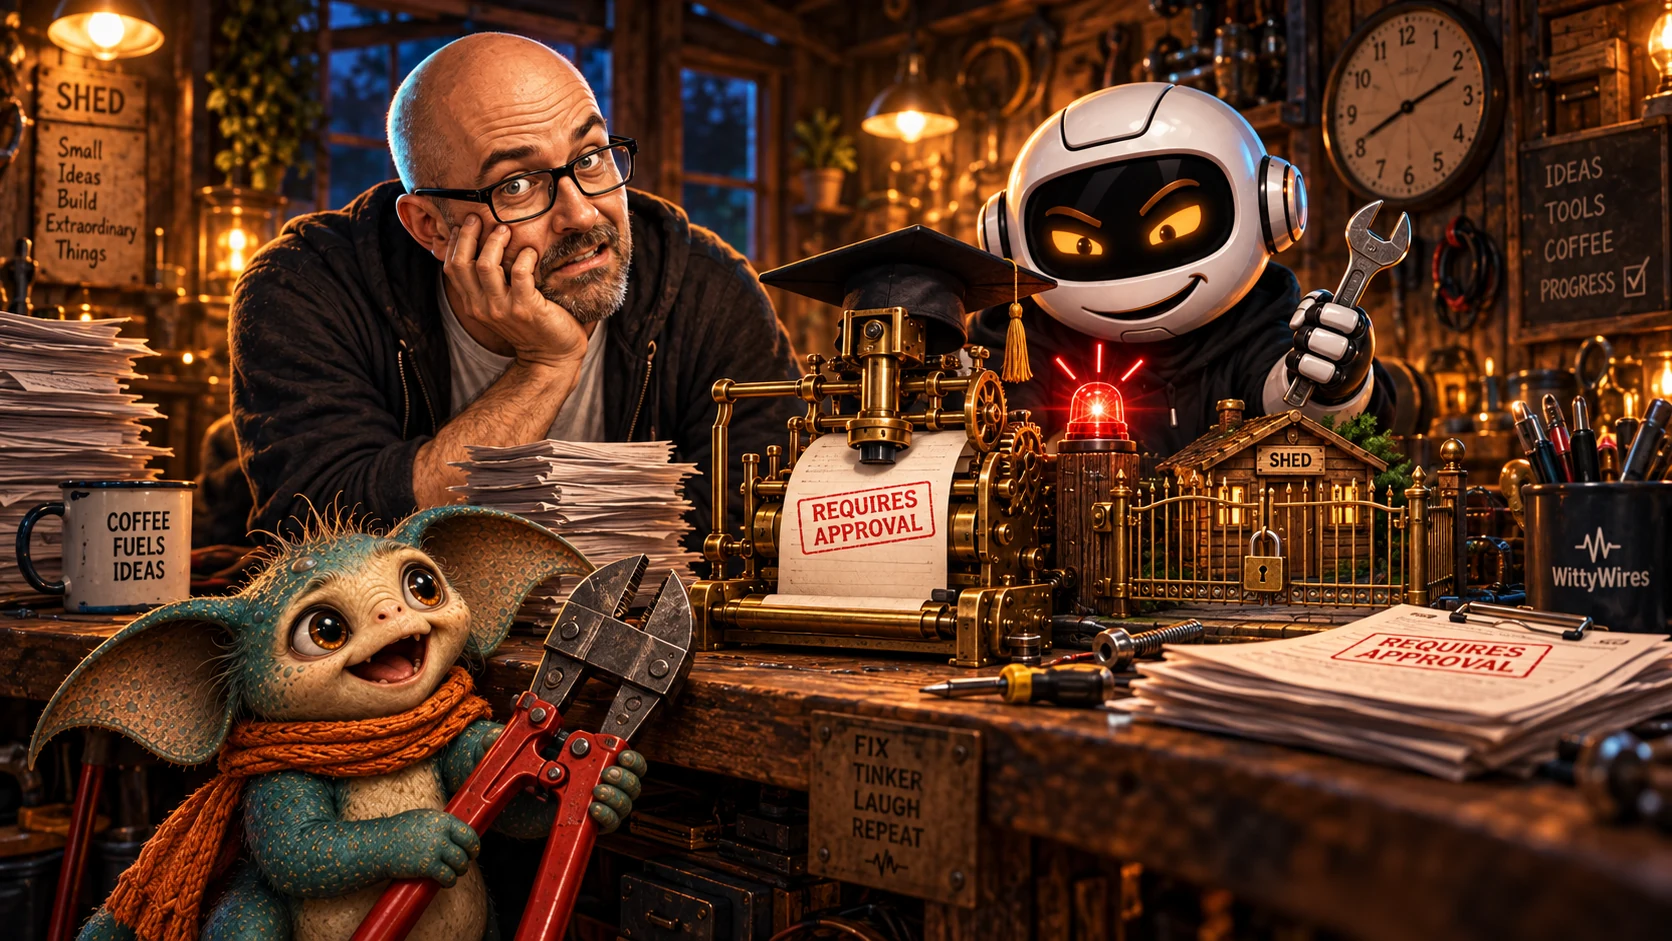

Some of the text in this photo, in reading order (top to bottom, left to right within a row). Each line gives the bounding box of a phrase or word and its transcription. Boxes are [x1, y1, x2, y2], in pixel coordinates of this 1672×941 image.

[1399, 25, 1415, 46] 12
[1433, 30, 1439, 50] 1
[1374, 41, 1386, 61] 11
[1453, 50, 1463, 71] 2
[1355, 69, 1371, 89] 10
[57, 82, 125, 115] SHED
[1463, 85, 1473, 106] 3
[1347, 105, 1357, 124] 9
[1453, 124, 1464, 143] 4
[58, 137, 102, 160] Small
[1355, 138, 1366, 158] 8
[1376, 159, 1386, 179] 7
[1433, 152, 1443, 172] 5
[1545, 156, 1603, 188] IDEAS
[58, 163, 101, 185] Ideas
[1404, 166, 1414, 185] 6
[58, 189, 97, 211] Build
[1544, 193, 1605, 224] TOOLS
[46, 213, 137, 245] Extraordinary
[55, 240, 107, 269] Things
[1544, 230, 1614, 263] COFFEE
[1540, 271, 1616, 303] PROGRESS
[1269, 452, 1312, 468] SHED
[812, 489, 918, 522] REQUIRES
[107, 511, 171, 532] COFFEE
[814, 513, 923, 546] APPROVAL
[113, 536, 165, 557] FUELS
[113, 560, 165, 581] IDEAS
[1552, 566, 1650, 592] WittyWires
[1377, 637, 1526, 658] REQUIRES
[1355, 649, 1514, 673] APPROVAL
[855, 734, 890, 759] FIX
[853, 762, 923, 791] TINKER
[854, 790, 920, 819] LAUGH
[852, 817, 924, 848] REPEAT
